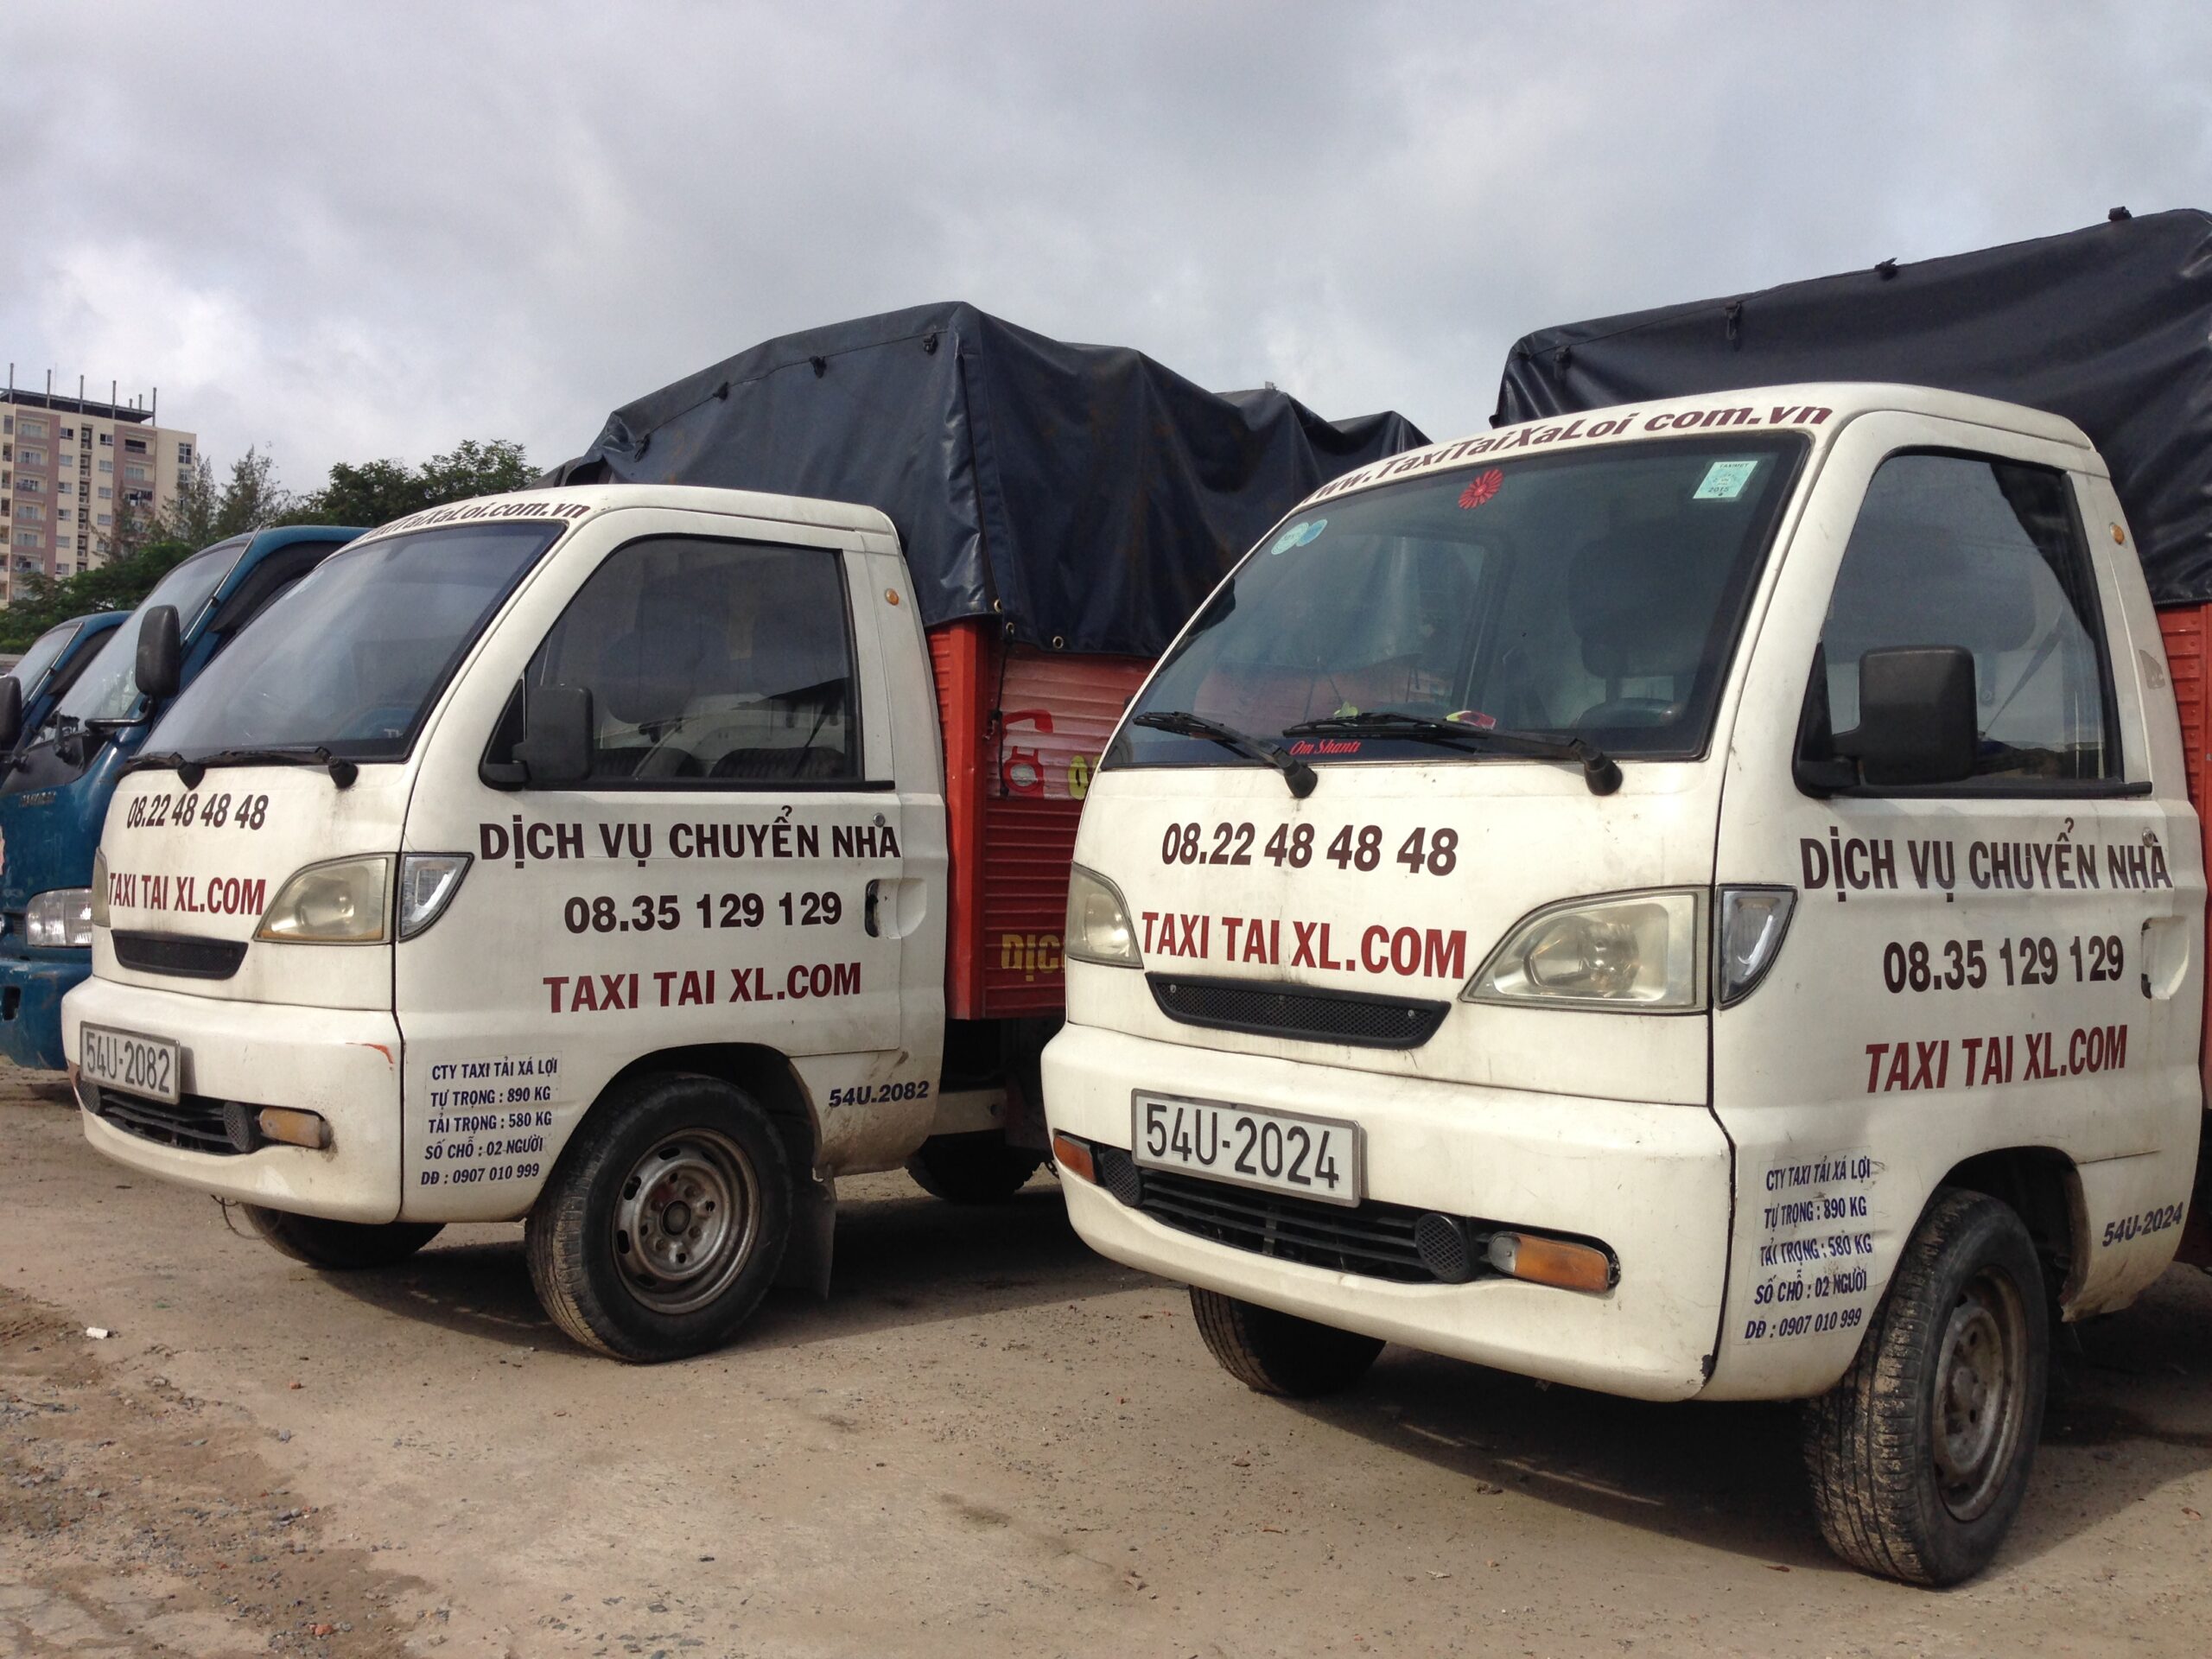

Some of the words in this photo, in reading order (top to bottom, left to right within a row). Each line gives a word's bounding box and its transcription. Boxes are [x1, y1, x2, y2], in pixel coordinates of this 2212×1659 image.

[1290, 740, 1314, 756] Om
[127, 792, 171, 830] 08.22
[171, 792, 199, 828] 48
[200, 792, 232, 829] 48
[234, 794, 270, 831] 48
[480, 814, 585, 869] DỊCH
[599, 823, 652, 868] VỤ
[669, 804, 820, 859] CHUYỂN
[1161, 822, 1256, 866] 08.22
[1264, 822, 1314, 869] 48
[1326, 823, 1383, 873] 48
[1396, 826, 1460, 877] 48
[1800, 825, 1898, 903] DỊCH
[1907, 840, 1955, 903] VỤ
[1968, 817, 2101, 890] CHUYỂN
[109, 872, 137, 908] TAXI
[141, 874, 169, 911] TAI
[174, 876, 266, 917] XL.COM
[563, 894, 681, 934] 08.35
[696, 893, 765, 929] 129
[779, 891, 842, 926] 129
[1001, 934, 1065, 982] DỊC
[1141, 911, 1210, 960] TAXI
[1221, 916, 1281, 966] TAI
[1291, 920, 1467, 981] XL.COM
[1883, 939, 1987, 995] 08.35
[1999, 936, 2059, 987] 129
[2069, 934, 2125, 983] 129
[543, 973, 639, 1014] TAXI
[653, 969, 715, 1007] TAI
[729, 962, 861, 1002] XL.COM
[86, 1031, 171, 1094] 54U-2082
[432, 1065, 457, 1081] CTY
[461, 1063, 490, 1079] TAXI
[494, 1056, 514, 1077] TẢI
[518, 1056, 534, 1076] XÁ
[538, 1057, 557, 1077] LỢI
[1865, 1039, 1950, 1094] TAXI
[1961, 1034, 2014, 1087] TAI
[2023, 1024, 2128, 1082] XL.COM
[431, 1089, 449, 1110] TỰ
[453, 1089, 495, 1109] TRỌNG
[507, 1086, 531, 1103] 890
[534, 1085, 550, 1102] KG
[429, 1112, 449, 1134] TẢI
[454, 1115, 497, 1135] TRỌNG
[508, 1111, 531, 1128] 580
[536, 1110, 552, 1127] KG
[424, 1137, 446, 1160] SỐ
[448, 1135, 474, 1160] CHỖ
[486, 1140, 503, 1156] 02
[506, 1133, 543, 1154] NGƯỜI
[1147, 1103, 1340, 1190] 54U-2024
[421, 1171, 440, 1185] DĐ
[452, 1167, 486, 1184] 0907
[489, 1165, 512, 1181] 010
[517, 1163, 540, 1179] 999
[1766, 1167, 1786, 1192] CTY
[1788, 1164, 1811, 1187] TAXI
[1814, 1154, 1830, 1184] TẢI
[1832, 1154, 1847, 1181] XÁ
[1851, 1157, 1871, 1184] LỢI
[1764, 1202, 1780, 1232] TỰ
[1781, 1200, 1814, 1229] TRỌNG
[1823, 1198, 1847, 1220] 890
[1850, 1195, 1867, 1217] KG
[1760, 1236, 1777, 1267] TẢI
[1780, 1237, 1821, 1266] TRỌNG
[1828, 1235, 1852, 1256] 580
[1855, 1233, 1872, 1254] KG
[1754, 1274, 1777, 1305] SỐ
[1777, 1268, 1803, 1303] CHỖ
[1815, 1277, 1830, 1298] 02
[1833, 1266, 1867, 1294] NGƯỜI
[1745, 1320, 1767, 1339] DĐ
[1779, 1314, 1812, 1337] 0907
[1815, 1311, 1838, 1332] 010
[1840, 1307, 1862, 1329] 999
